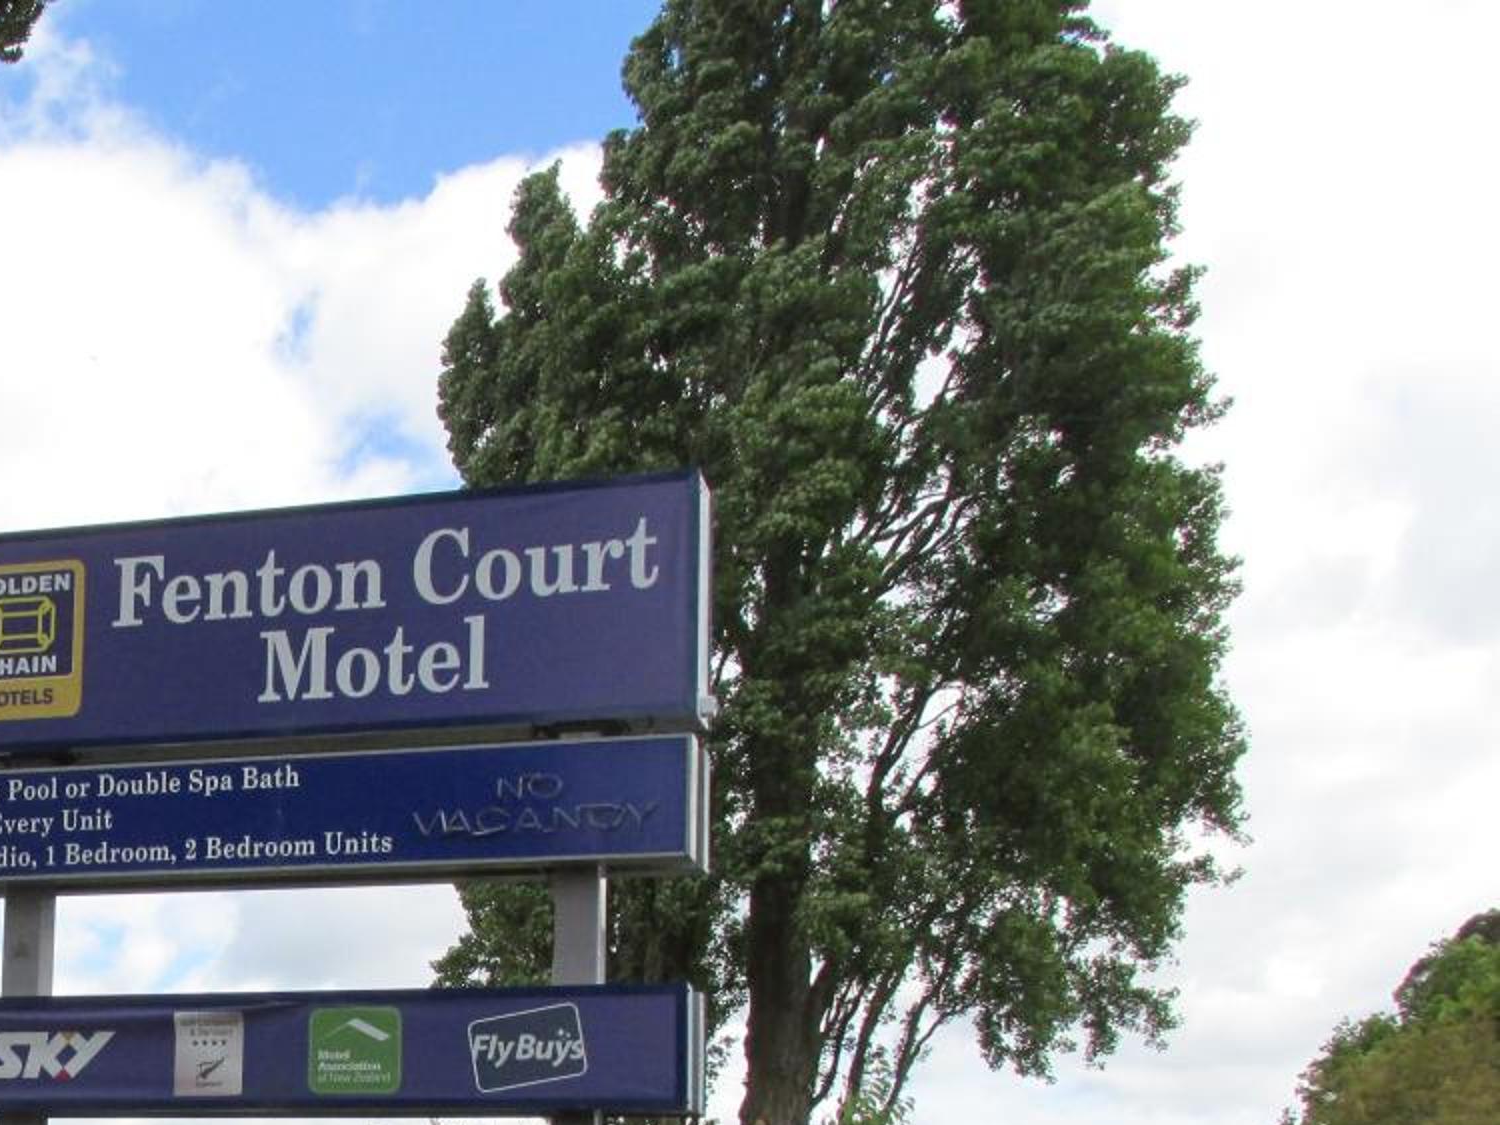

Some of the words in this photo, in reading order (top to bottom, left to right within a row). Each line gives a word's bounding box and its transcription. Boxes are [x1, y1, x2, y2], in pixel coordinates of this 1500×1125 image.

[111, 549, 387, 627] Fenton
[412, 516, 660, 604] Court
[257, 614, 490, 702] Motel
[8, 776, 57, 801] Pool
[65, 779, 91, 799] or
[98, 770, 180, 798] Double
[188, 769, 233, 796] Spa
[242, 763, 300, 790] Bath
[496, 772, 564, 799] NO
[62, 808, 113, 832] Unit
[46, 845, 56, 866] 1
[65, 839, 177, 866] Bedroom,
[185, 838, 197, 860] 2
[206, 835, 316, 860] Bedroom
[324, 830, 393, 855] Units
